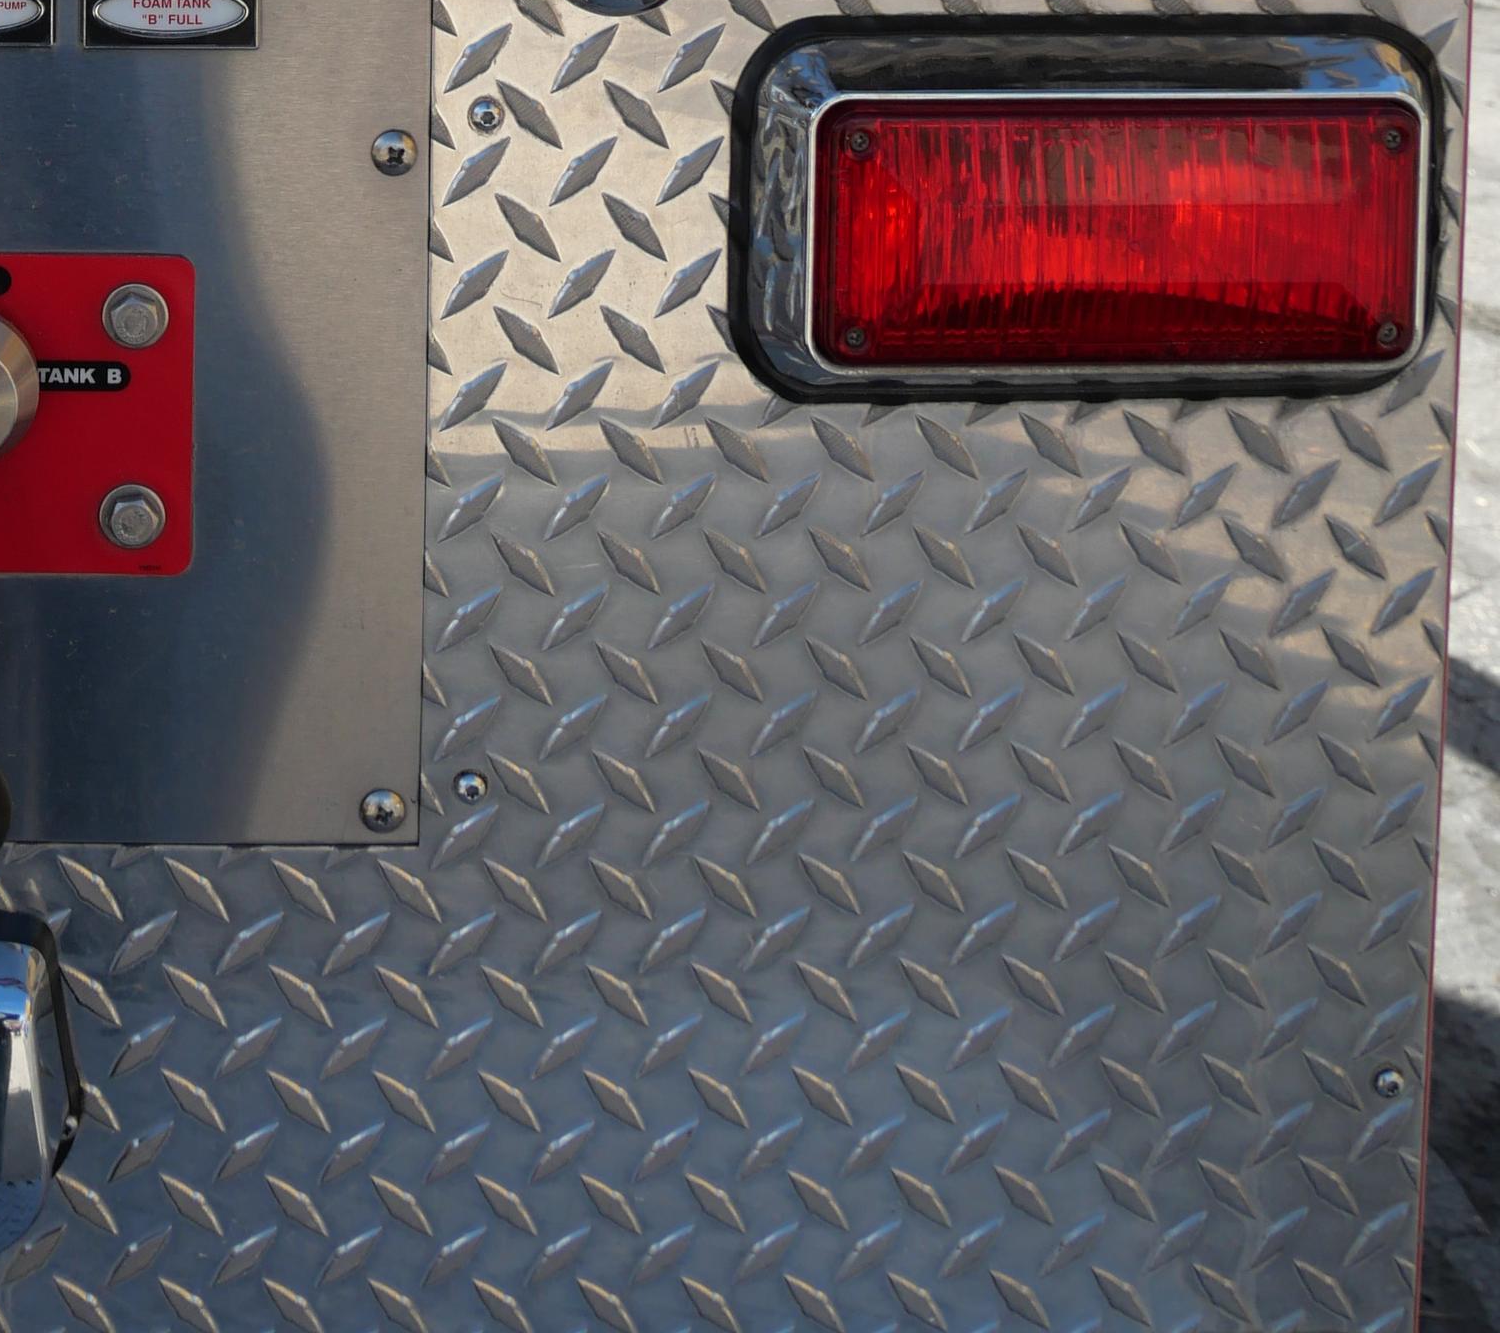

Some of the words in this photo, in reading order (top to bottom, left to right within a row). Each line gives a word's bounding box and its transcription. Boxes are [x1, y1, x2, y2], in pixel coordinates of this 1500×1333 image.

[141, 14, 164, 25] "B"
[168, 14, 203, 25] FULL
[37, 368, 95, 384] TANK
[107, 368, 122, 384] B
